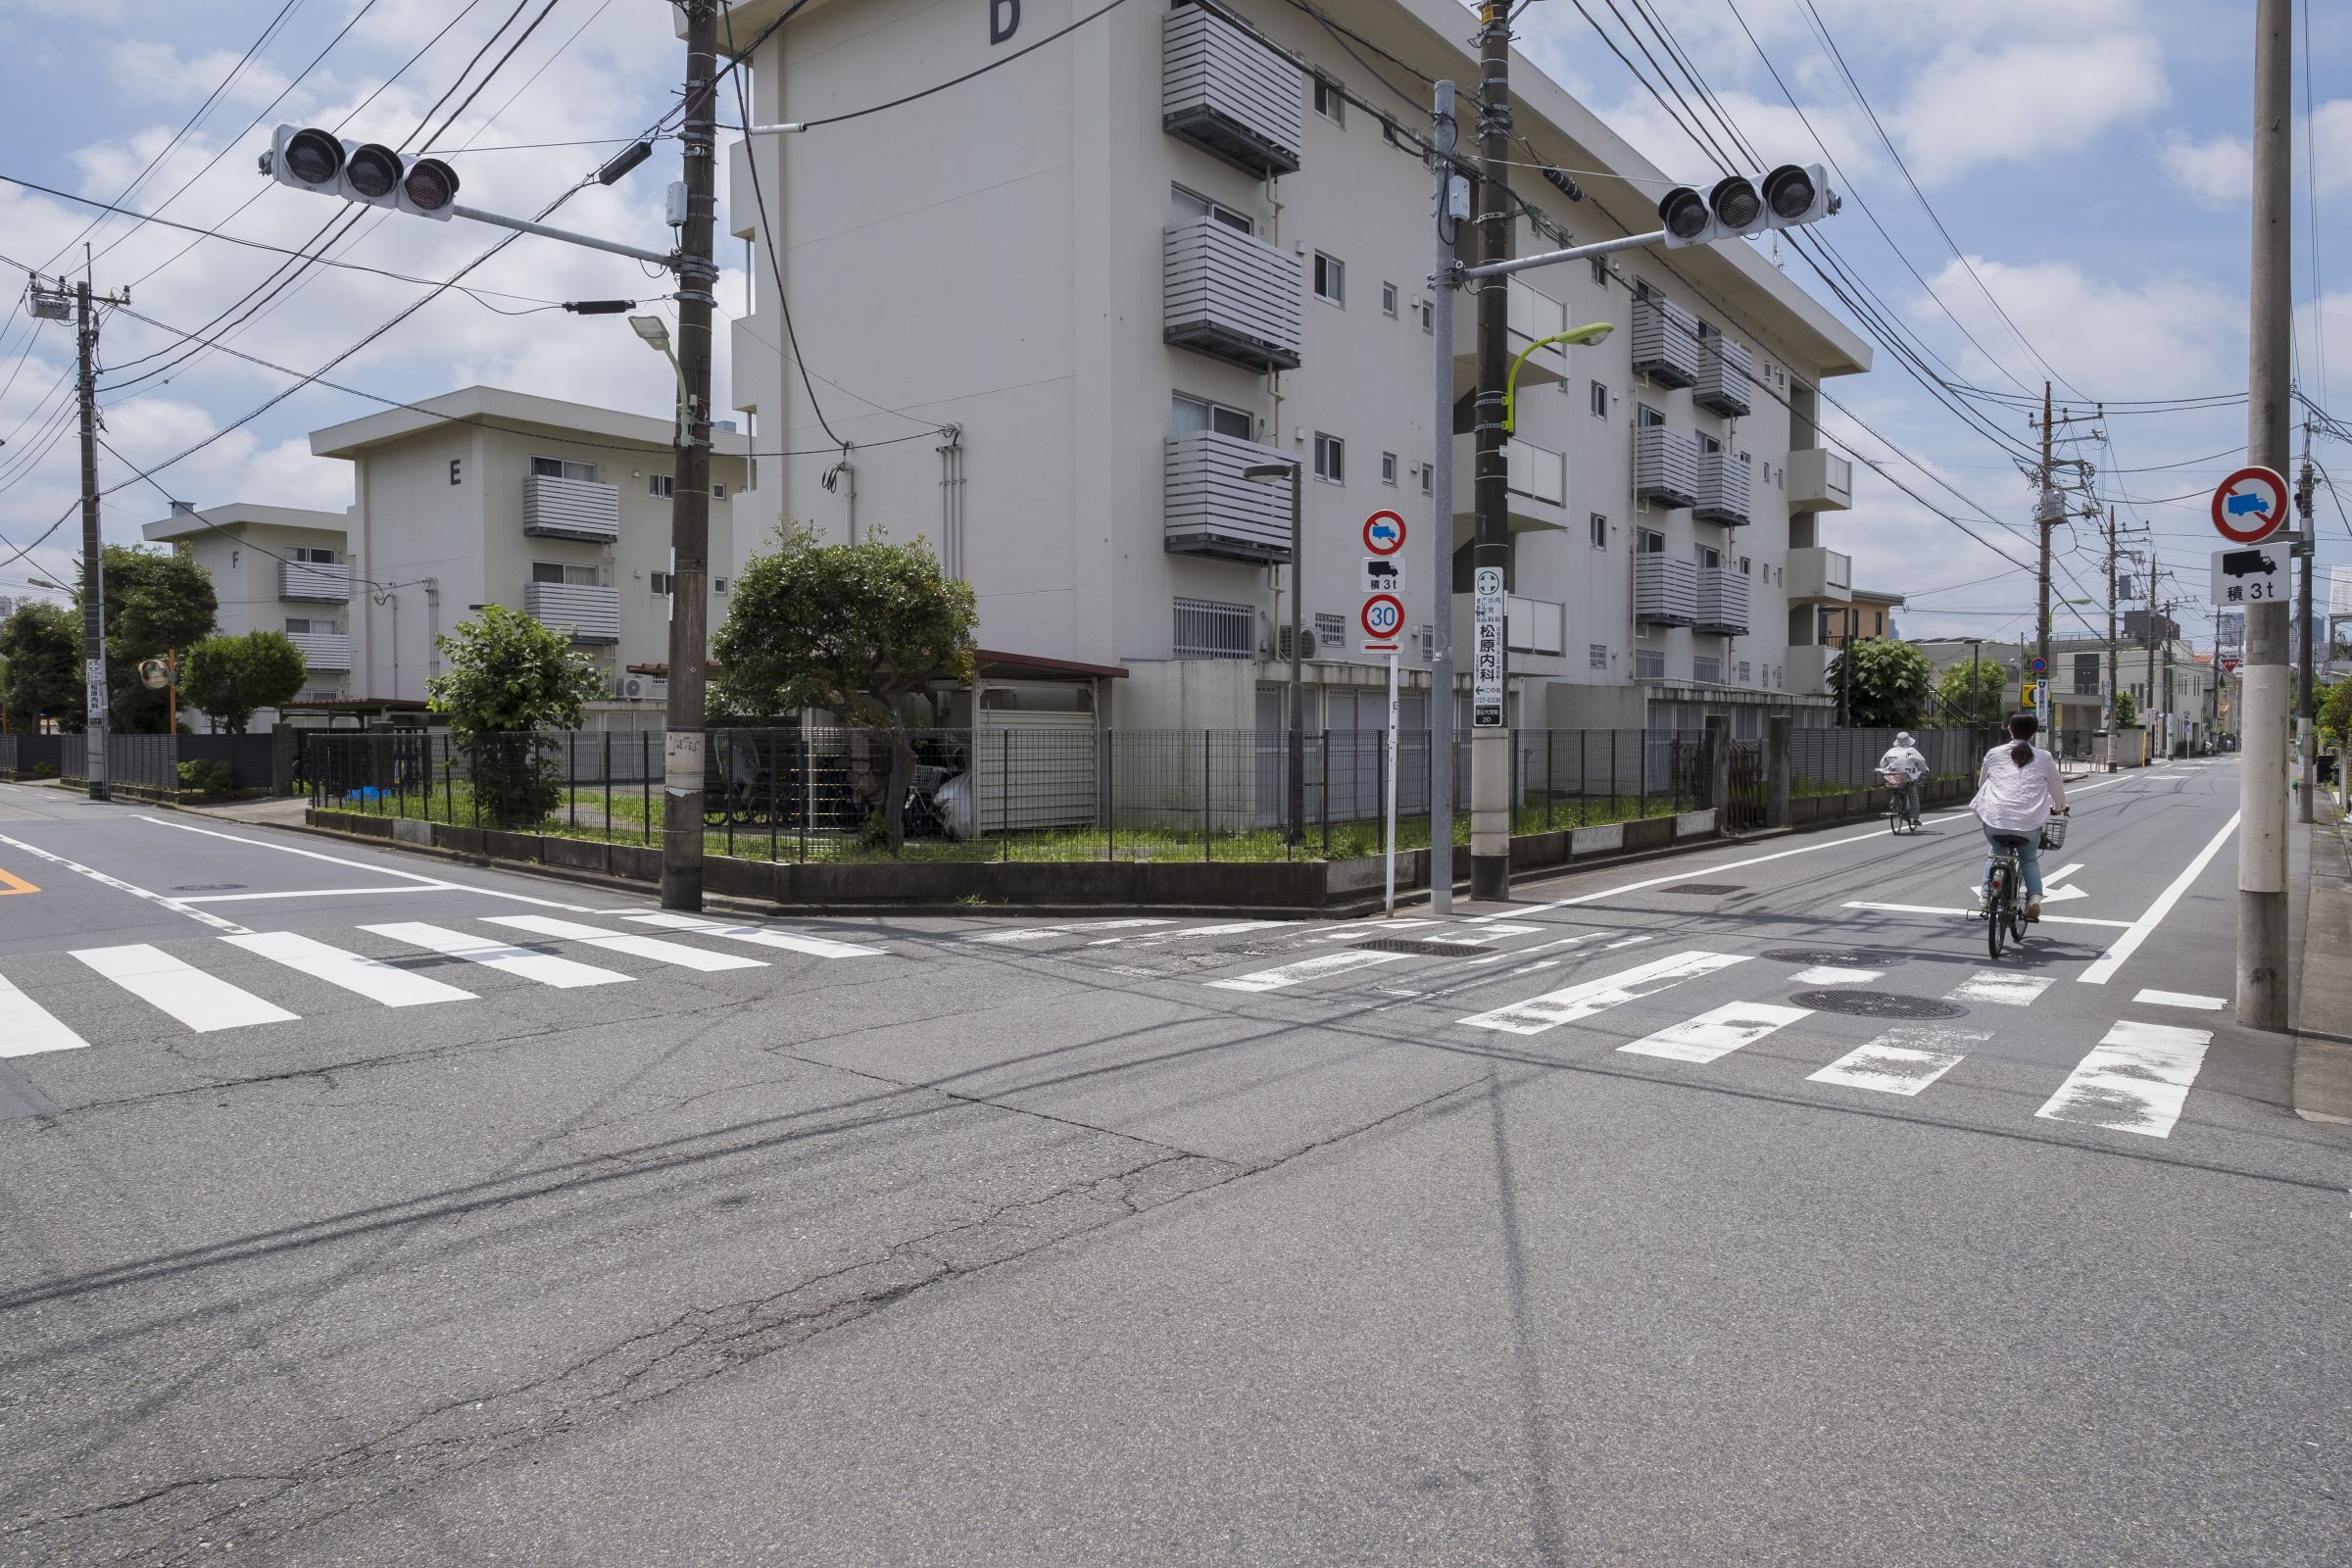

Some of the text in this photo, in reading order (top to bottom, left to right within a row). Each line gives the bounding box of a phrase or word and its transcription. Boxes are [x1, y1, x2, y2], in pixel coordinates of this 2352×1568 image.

[990, 0, 1020, 46] D
[450, 459, 462, 486] E
[232, 550, 239, 569] F
[1383, 579, 1397, 590] 3t
[2227, 581, 2275, 602] 積 3t
[1371, 607, 1396, 627] 30
[1480, 624, 1495, 683] 松原内科
